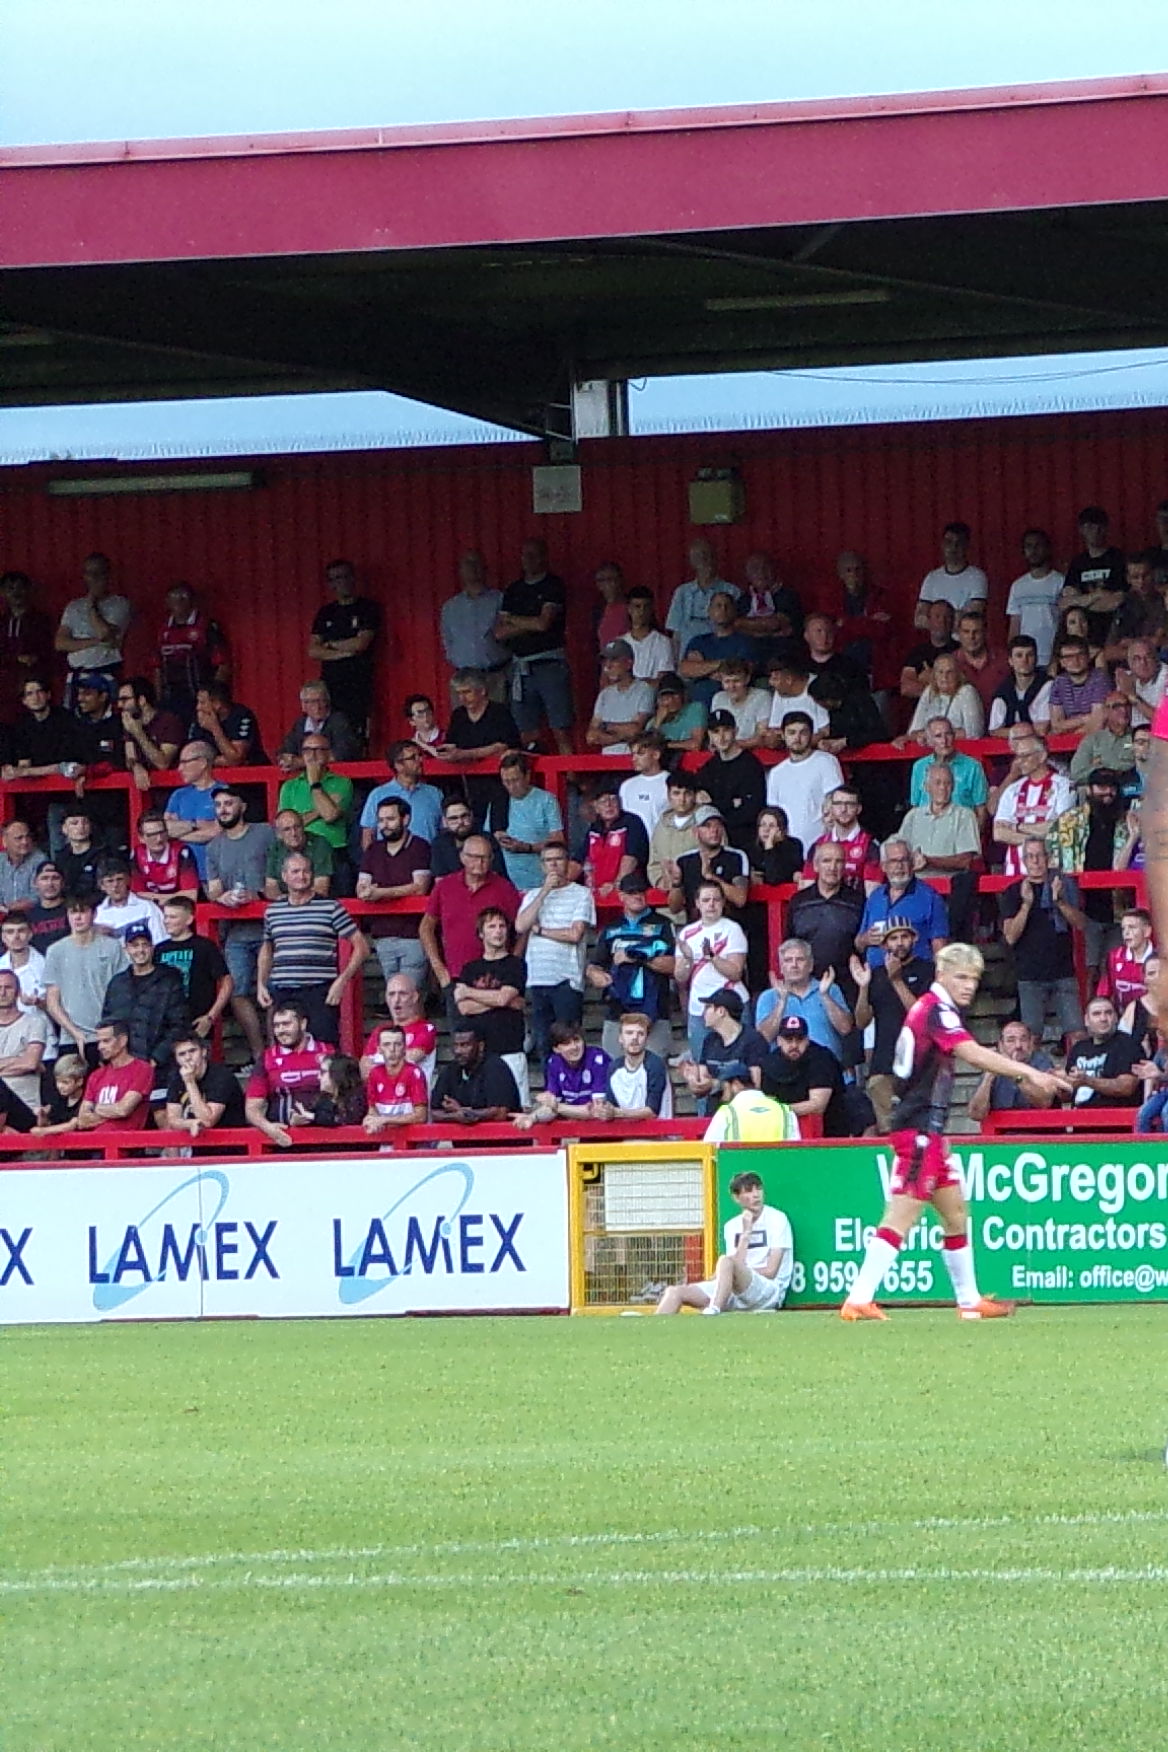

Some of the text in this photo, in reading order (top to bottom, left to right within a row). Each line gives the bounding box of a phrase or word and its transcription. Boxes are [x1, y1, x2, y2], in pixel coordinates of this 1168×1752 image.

[333, 1212, 527, 1277] LAMEX
[983, 1214, 1167, 1250] Contractors
[88, 1219, 281, 1284] LAMEX
[874, 1260, 934, 1293] 655
[1012, 1265, 1074, 1288] Email:
